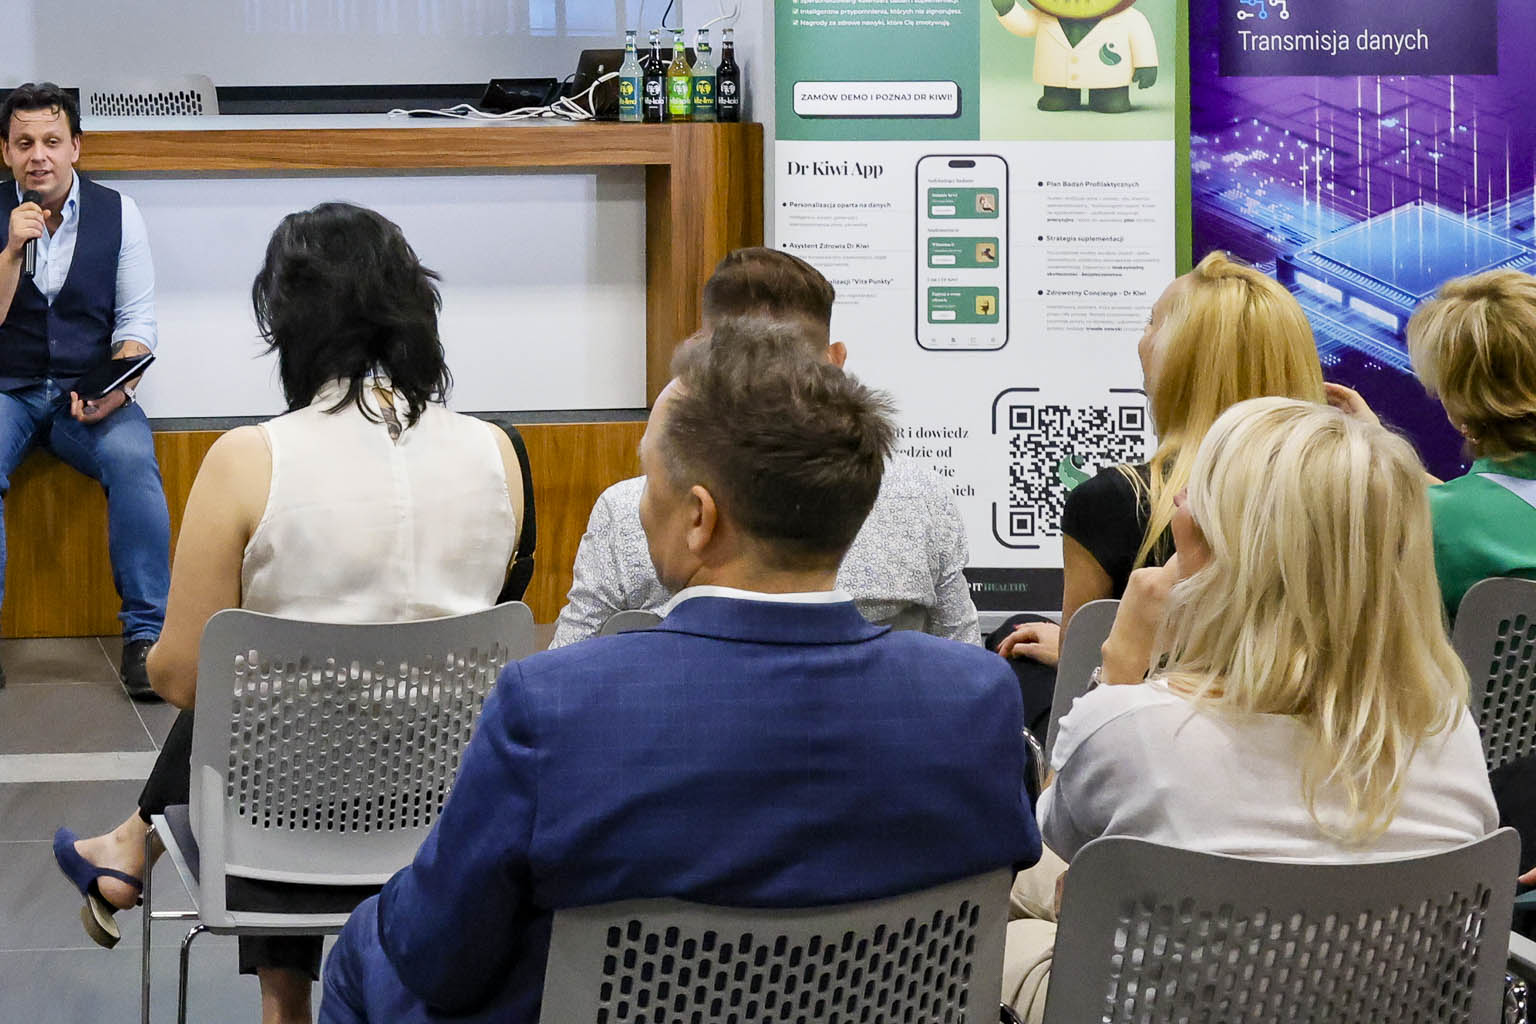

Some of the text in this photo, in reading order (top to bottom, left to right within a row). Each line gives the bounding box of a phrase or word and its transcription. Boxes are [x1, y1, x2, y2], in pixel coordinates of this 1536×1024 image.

[1238, 29, 1429, 55] Transmisja danych
[800, 91, 838, 101] ZAMÓW
[840, 93, 868, 101] DEMO
[875, 93, 911, 101] POZNAJ
[913, 93, 926, 101] DR
[929, 93, 953, 101] KIWI!
[787, 160, 884, 179] Dr Kiwi App
[908, 426, 912, 438] i
[915, 426, 969, 438] dowiedz
[936, 446, 952, 458] od
